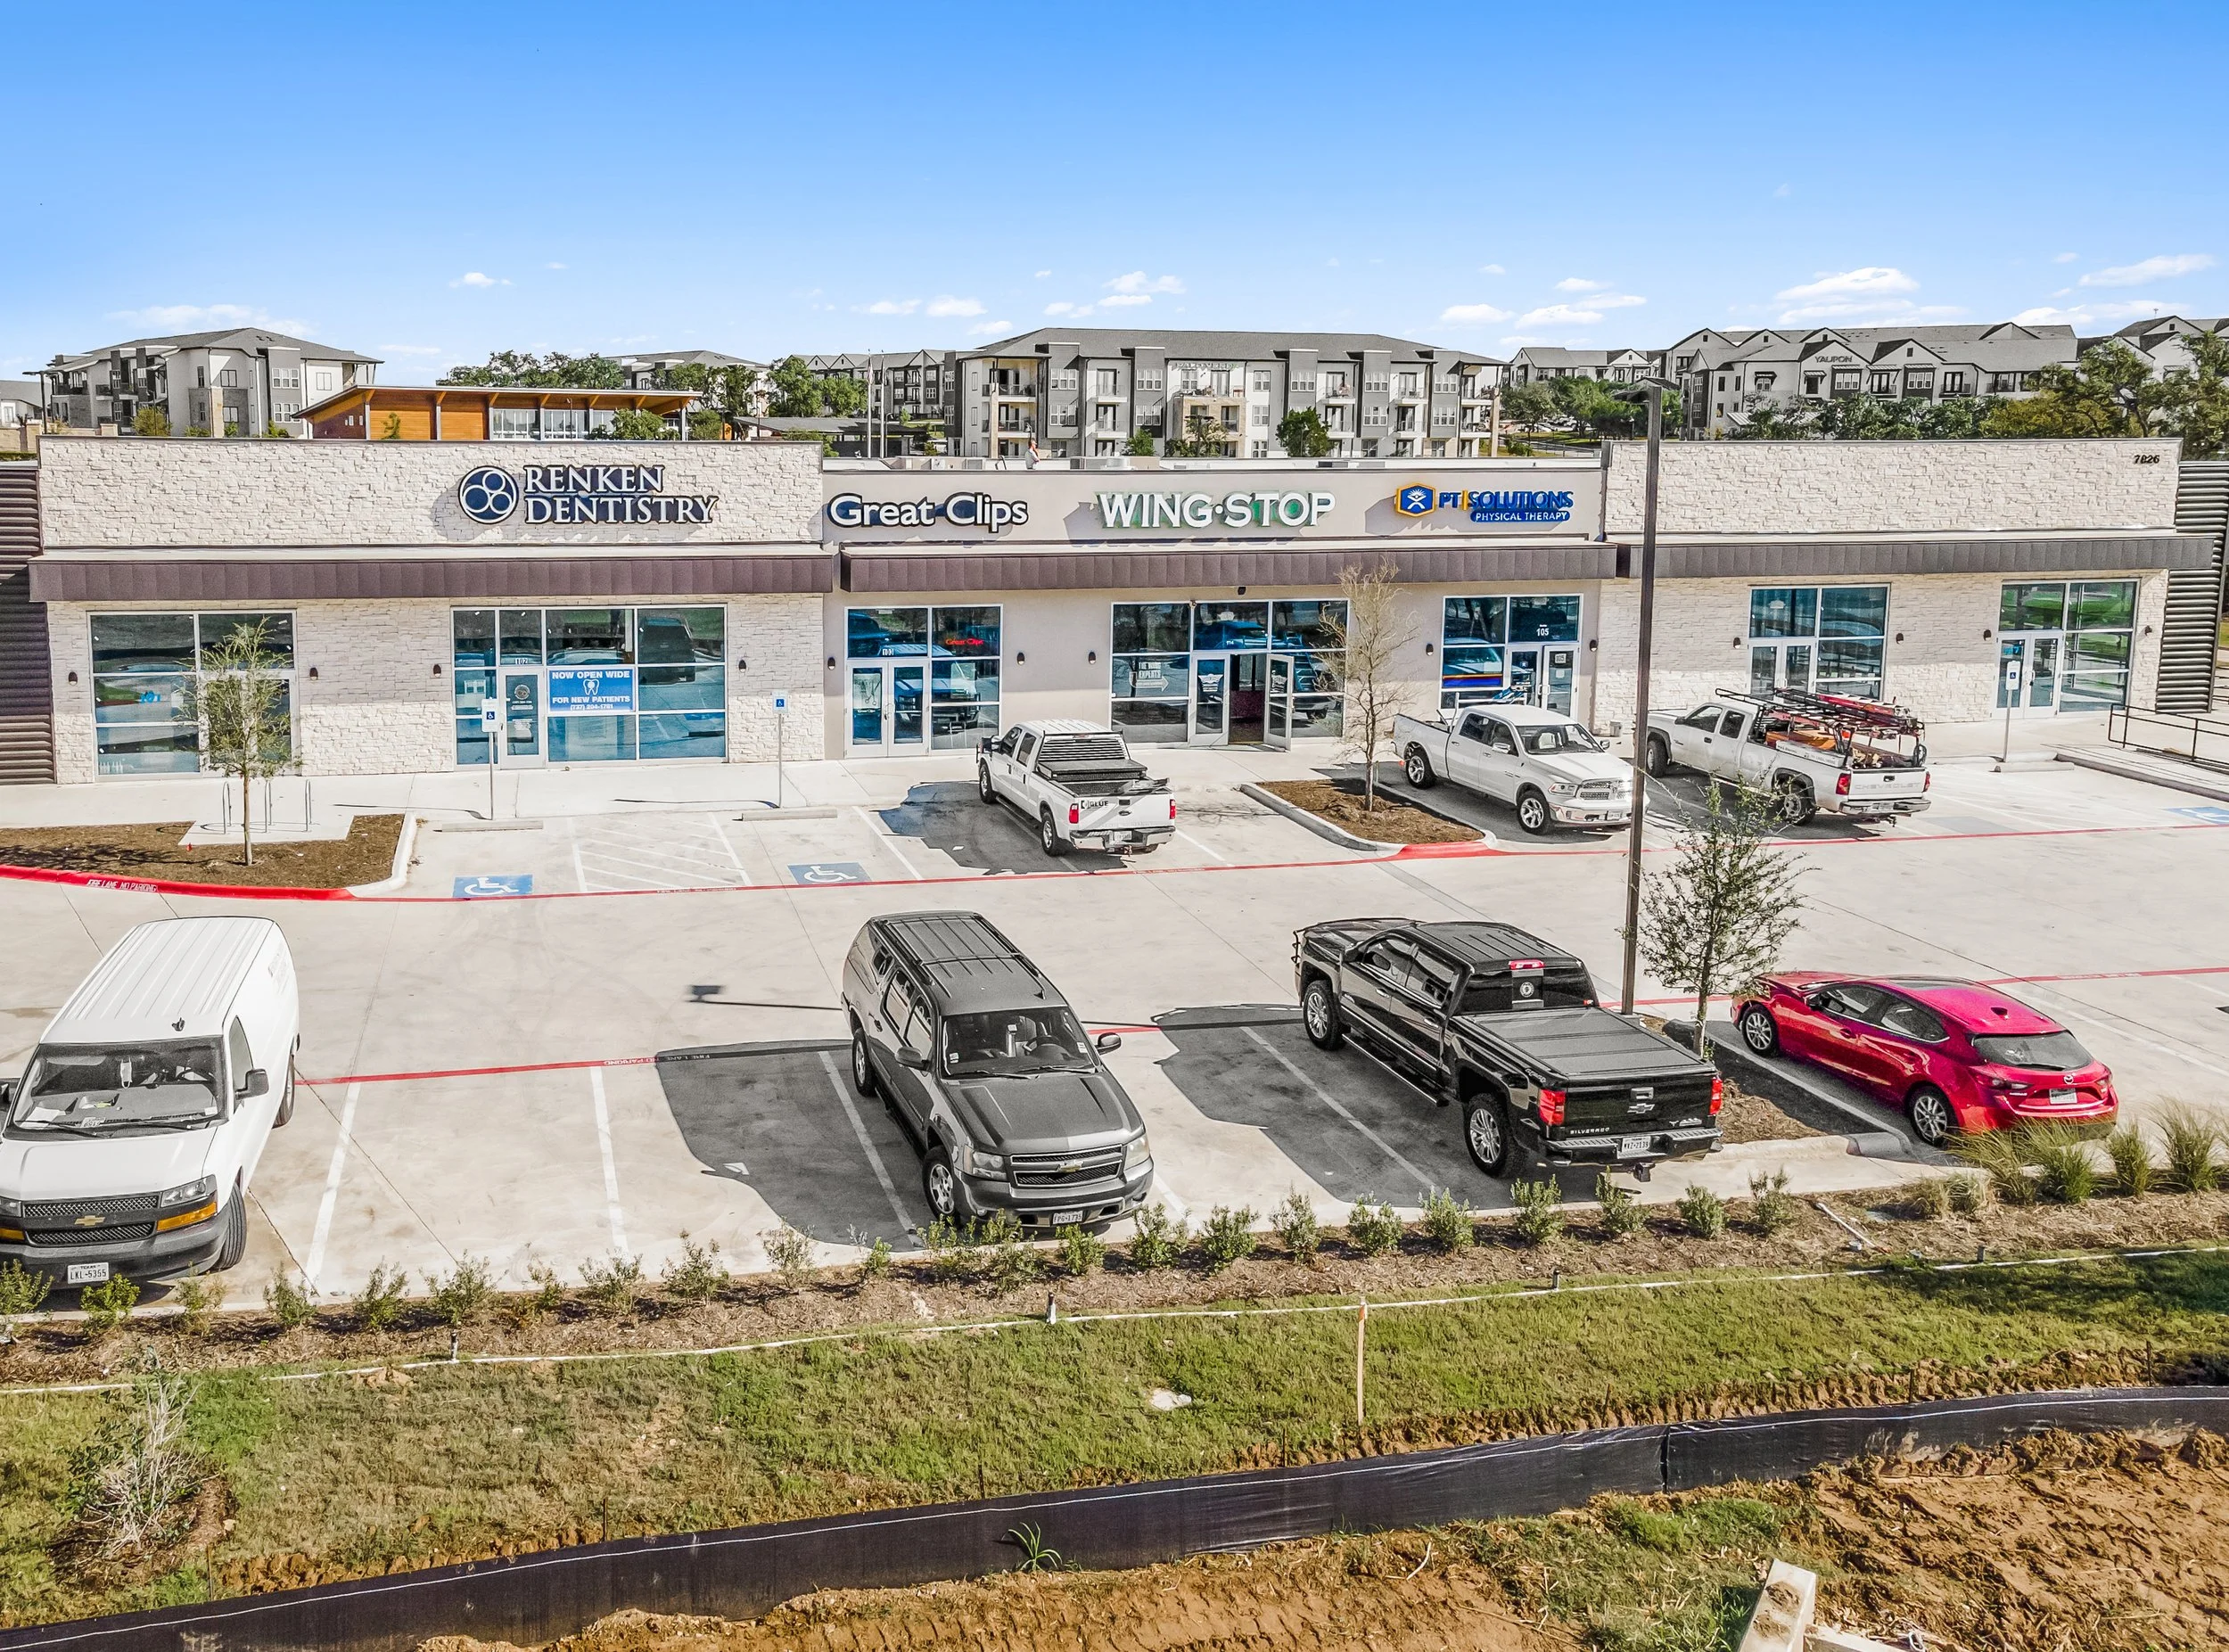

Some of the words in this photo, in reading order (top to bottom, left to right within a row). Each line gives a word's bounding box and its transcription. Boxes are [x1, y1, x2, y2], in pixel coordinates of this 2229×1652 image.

[2134, 454, 2159, 464] 7826
[524, 465, 664, 493] RENKEN
[1438, 491, 1460, 508] PT
[1468, 490, 1574, 509] SOLUTIONS
[524, 496, 718, 524] DENTISTRY
[827, 493, 936, 528] Great
[944, 492, 1029, 533] Clips
[1476, 513, 1522, 521] PHYSICAL
[1525, 512, 1567, 521] THERAPY
[1536, 628, 1550, 637] 105
[552, 671, 573, 679] NOW
